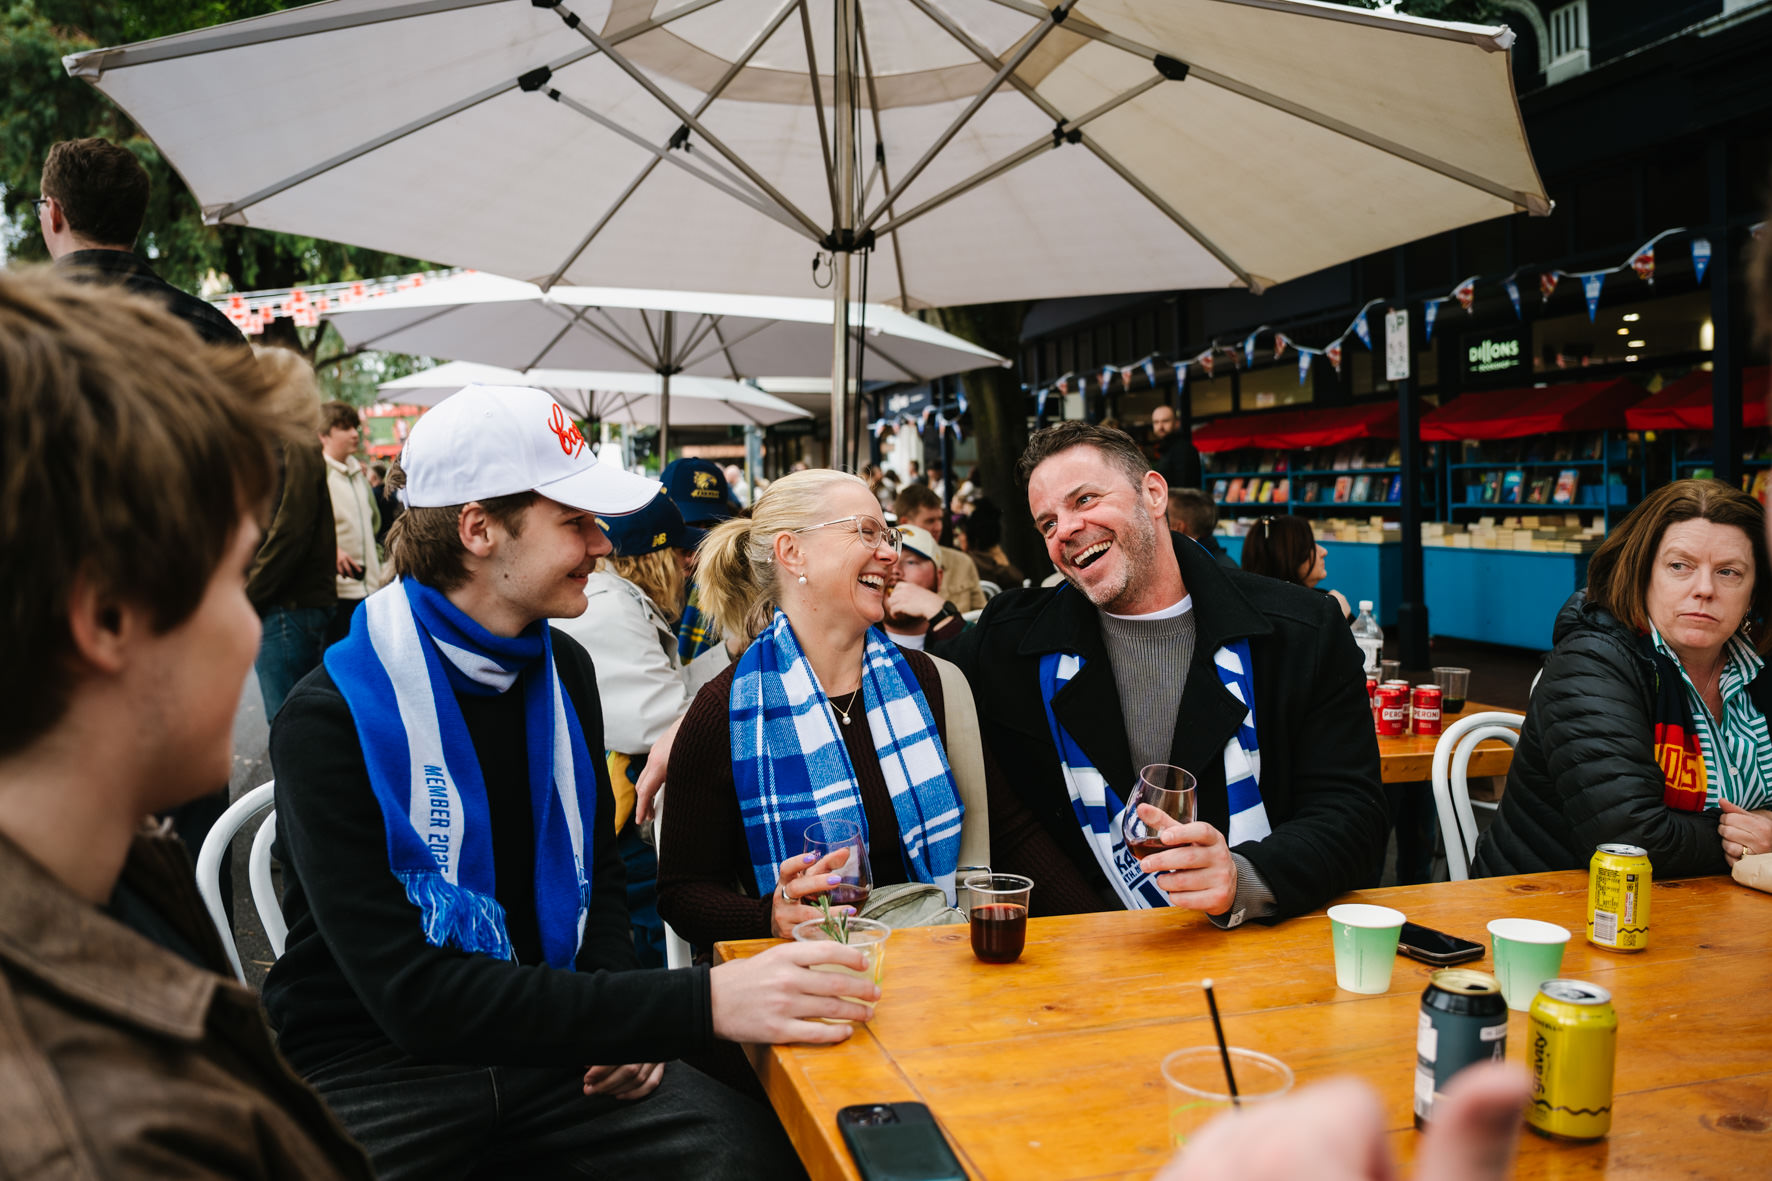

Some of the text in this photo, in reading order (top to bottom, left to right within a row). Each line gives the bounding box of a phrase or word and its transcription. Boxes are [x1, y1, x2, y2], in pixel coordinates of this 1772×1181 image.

[652, 532, 667, 547] NB
[1414, 710, 1439, 719] PERONI
[424, 765, 450, 828] MEMBER
